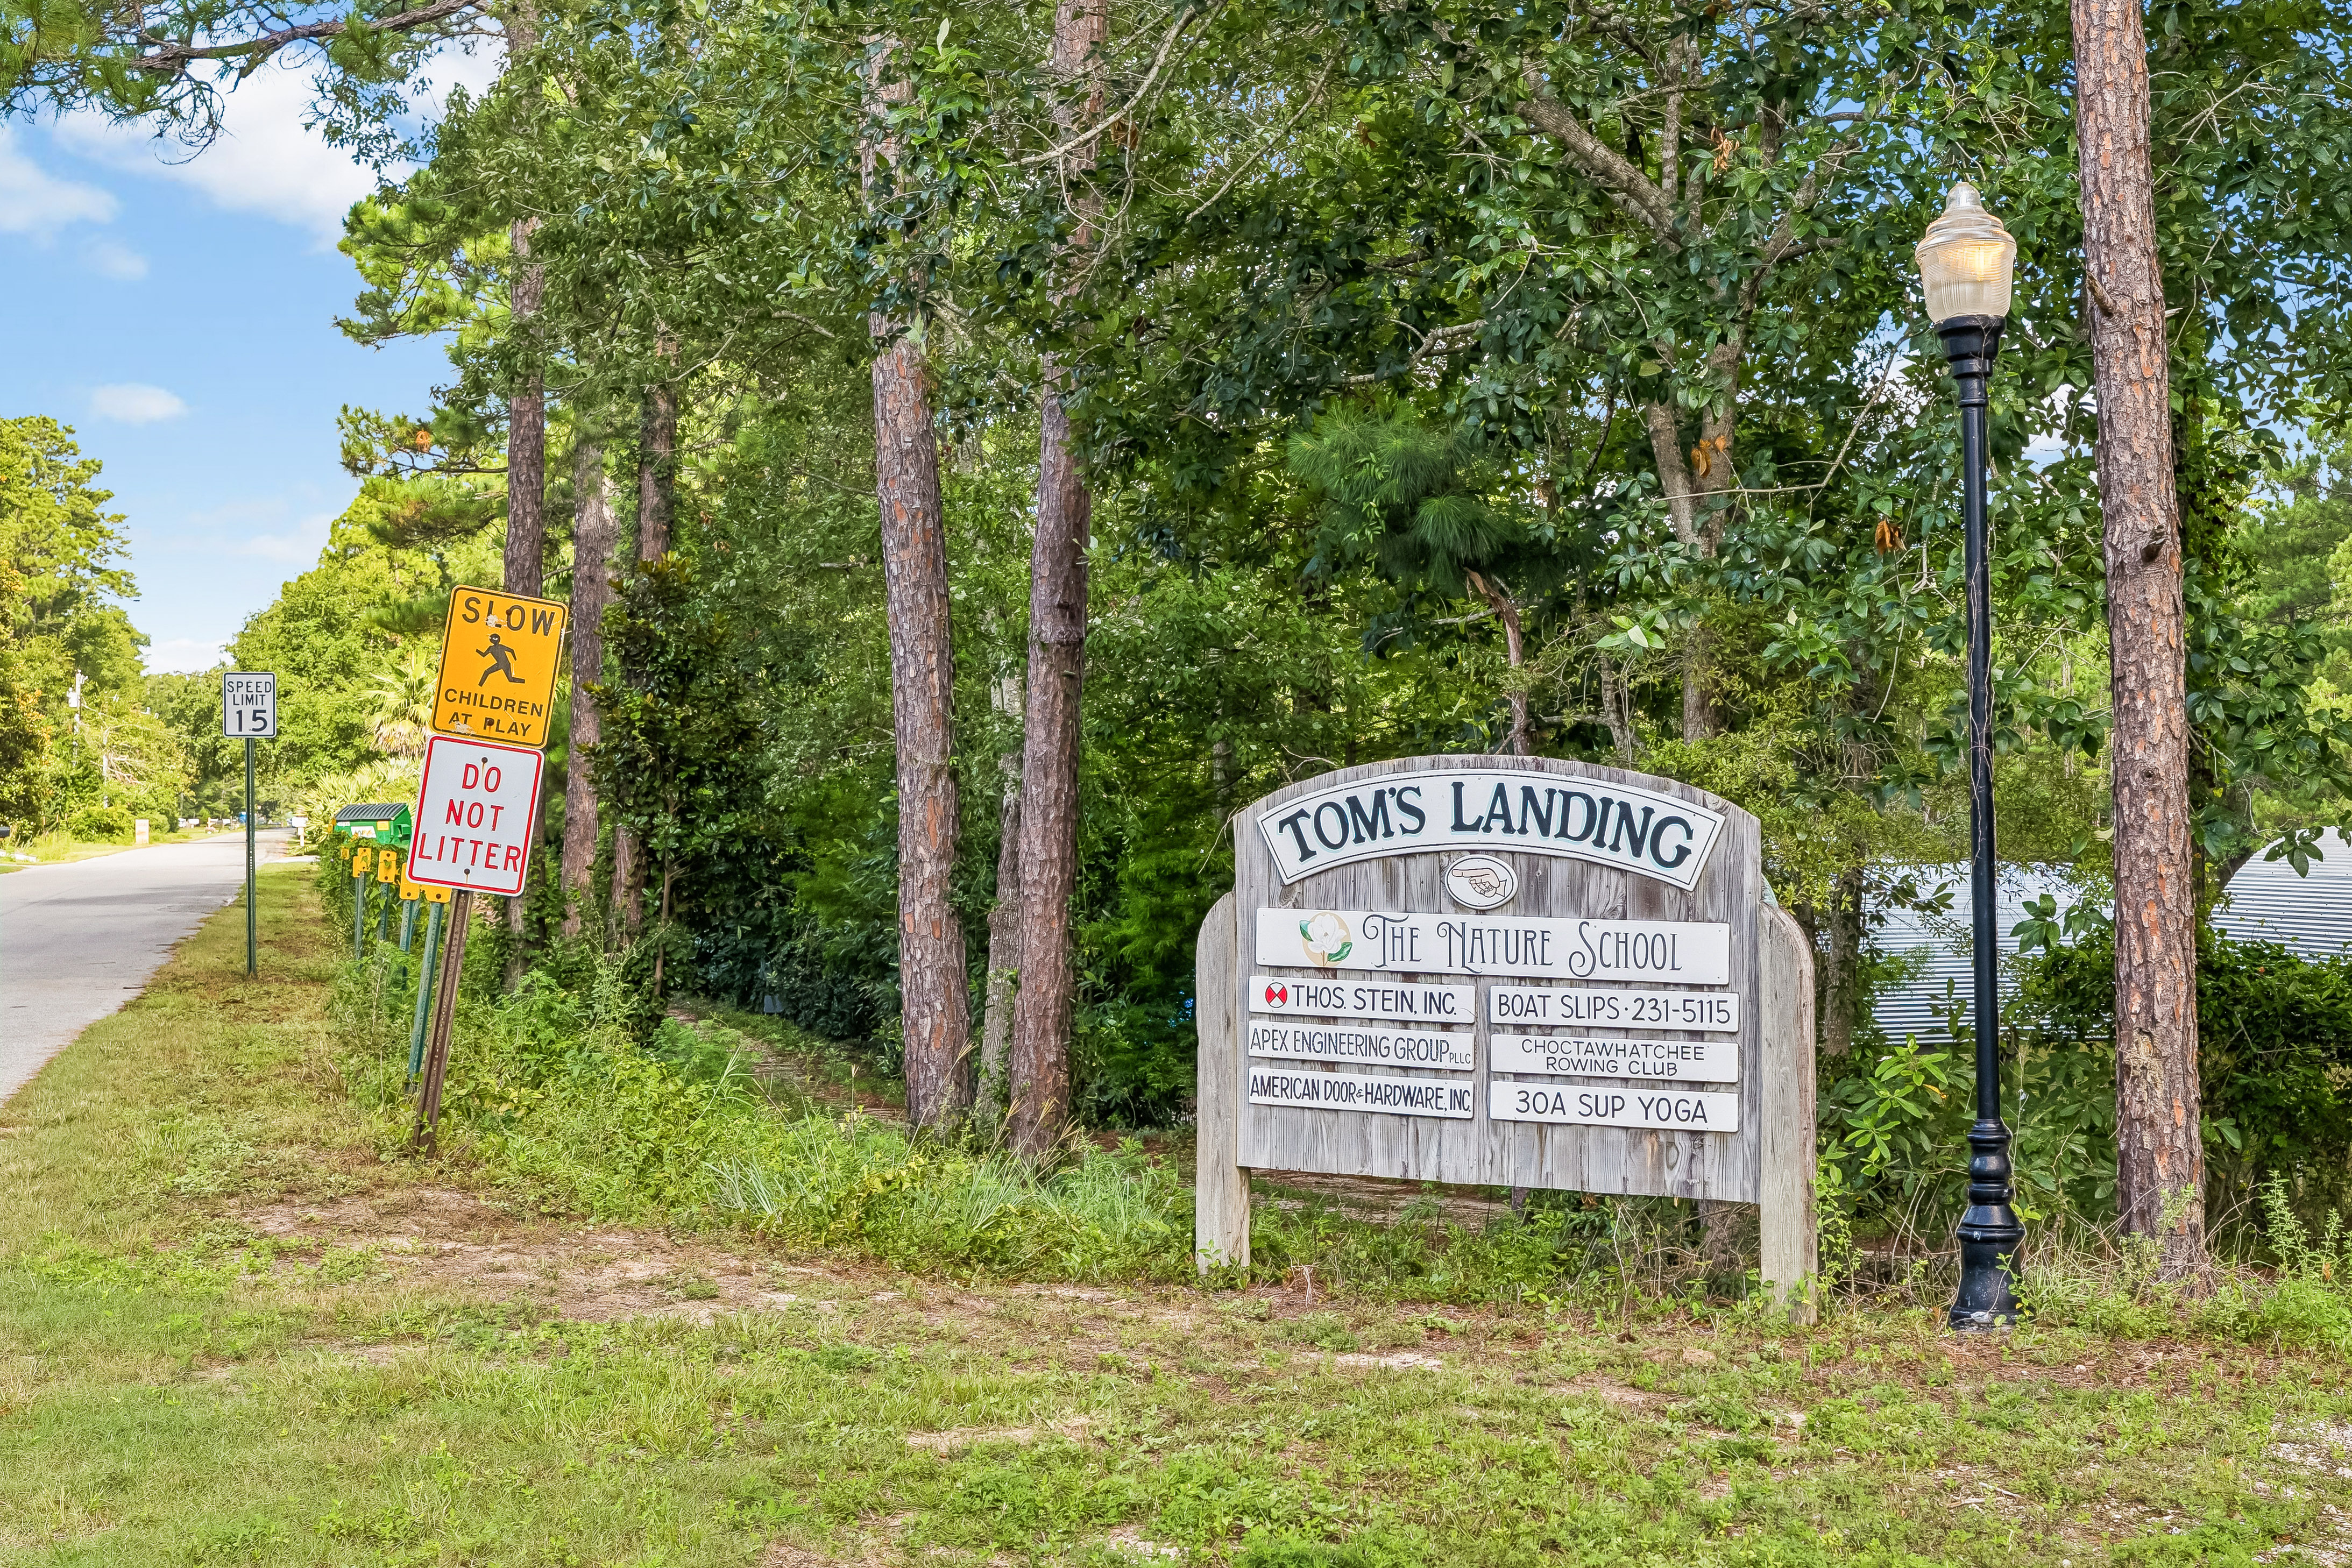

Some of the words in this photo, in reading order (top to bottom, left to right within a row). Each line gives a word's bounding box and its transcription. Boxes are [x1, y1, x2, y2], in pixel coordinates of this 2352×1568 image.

[462, 597, 555, 636] SLOW
[227, 680, 272, 693] SPEED
[233, 694, 266, 706] LIMIT
[444, 689, 543, 717] CHILDREN
[236, 709, 267, 732] 15
[448, 712, 472, 726] AT
[483, 717, 532, 736] PLAY
[462, 763, 501, 792] DO
[445, 799, 505, 831] NOT
[1278, 785, 1426, 863] TOM'S
[1450, 781, 1694, 868] LANDING
[418, 833, 521, 872] LITTER
[1362, 914, 1422, 968] THE
[1436, 921, 1553, 974] NATURE
[1569, 921, 1683, 977] SCHOOL
[1291, 984, 1347, 1010] THOS.
[1353, 988, 1417, 1015] STEIN,
[1423, 991, 1457, 1016] INC.
[1498, 994, 1552, 1017] BOAT
[1250, 1028, 1288, 1052] APEX
[1294, 1031, 1390, 1058] ENGINEERING
[1394, 1037, 1450, 1063] GROUP
[1449, 1052, 1471, 1065] PLLC
[1521, 1039, 1705, 1061] CHOCTAWHATCHEE
[1546, 1056, 1619, 1074] ROWING
[1628, 1061, 1678, 1076] CLUB
[1250, 1075, 1320, 1101] AMERICAN
[1449, 1088, 1471, 1112] INC.
[1515, 1090, 1566, 1116] 30A
[1578, 1094, 1625, 1118] SUP
[1638, 1096, 1708, 1124] YOGA
